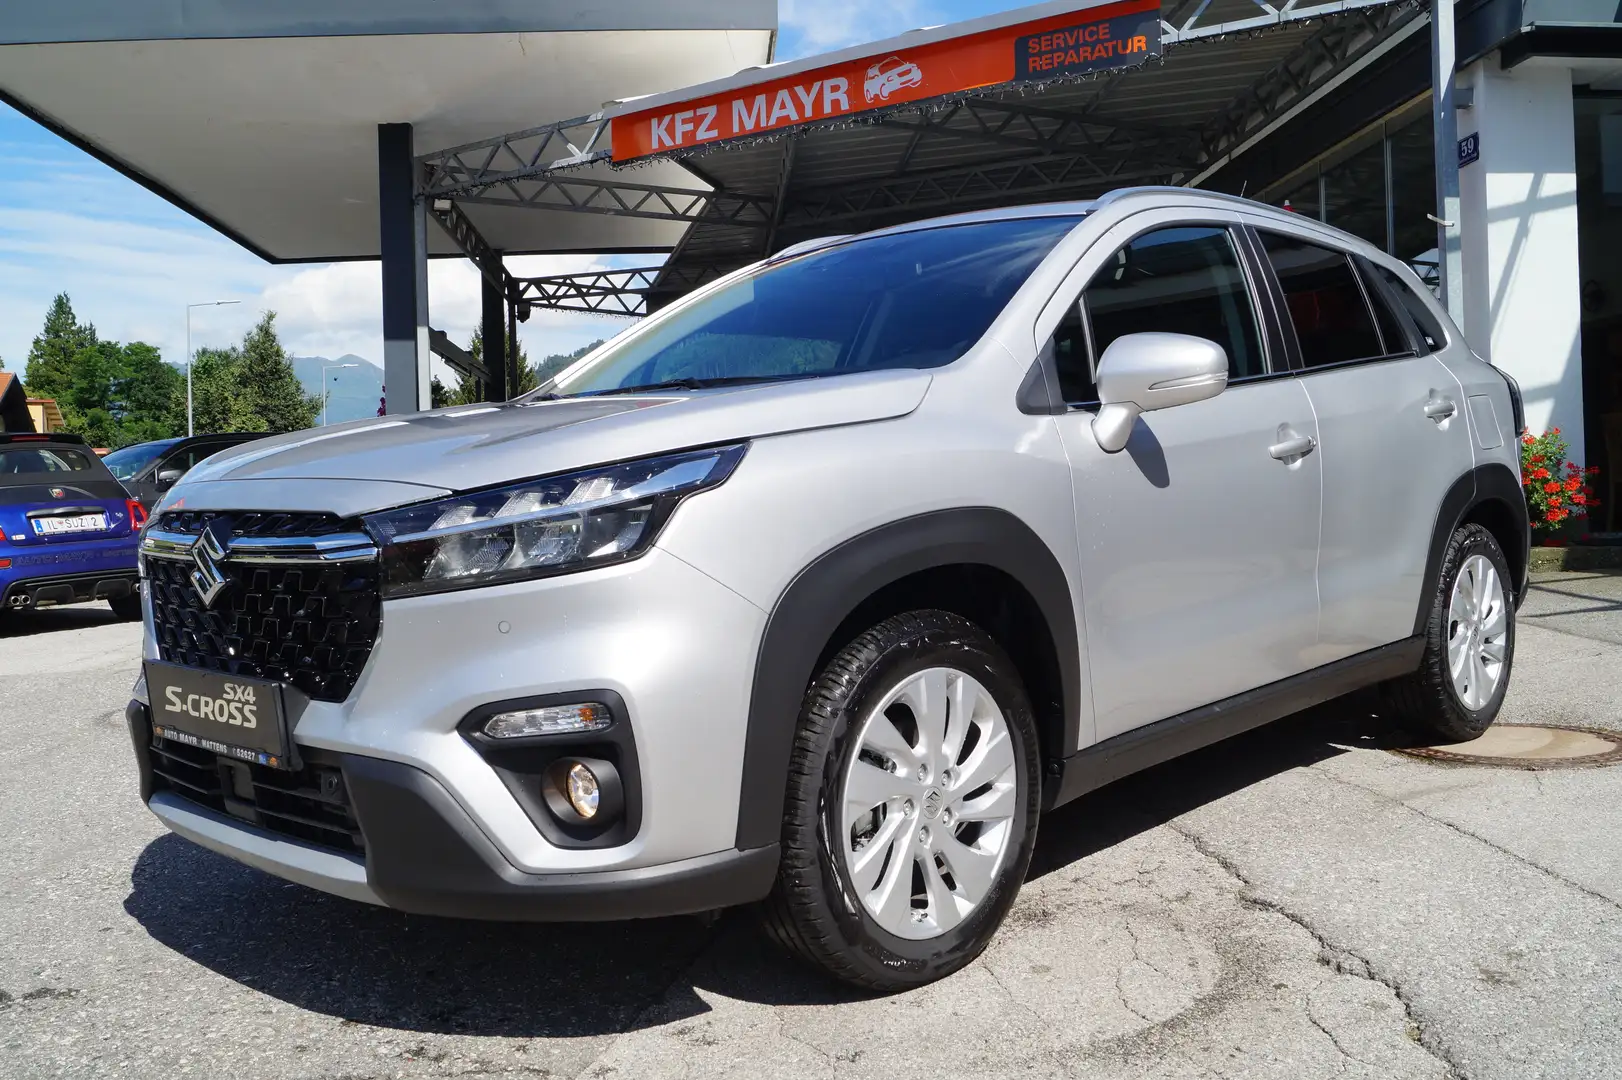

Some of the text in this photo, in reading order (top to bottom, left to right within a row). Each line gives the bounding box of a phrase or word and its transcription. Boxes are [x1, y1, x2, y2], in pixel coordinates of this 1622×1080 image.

[1028, 23, 1110, 53] SERVICE
[1028, 35, 1147, 73] REPARATUR
[651, 77, 849, 149] KFZ MAYR
[1461, 137, 1474, 157] 59
[222, 682, 256, 704] SX4
[164, 729, 178, 740] AUTO
[179, 733, 198, 745] MAYR
[201, 738, 228, 754] WATTENS
